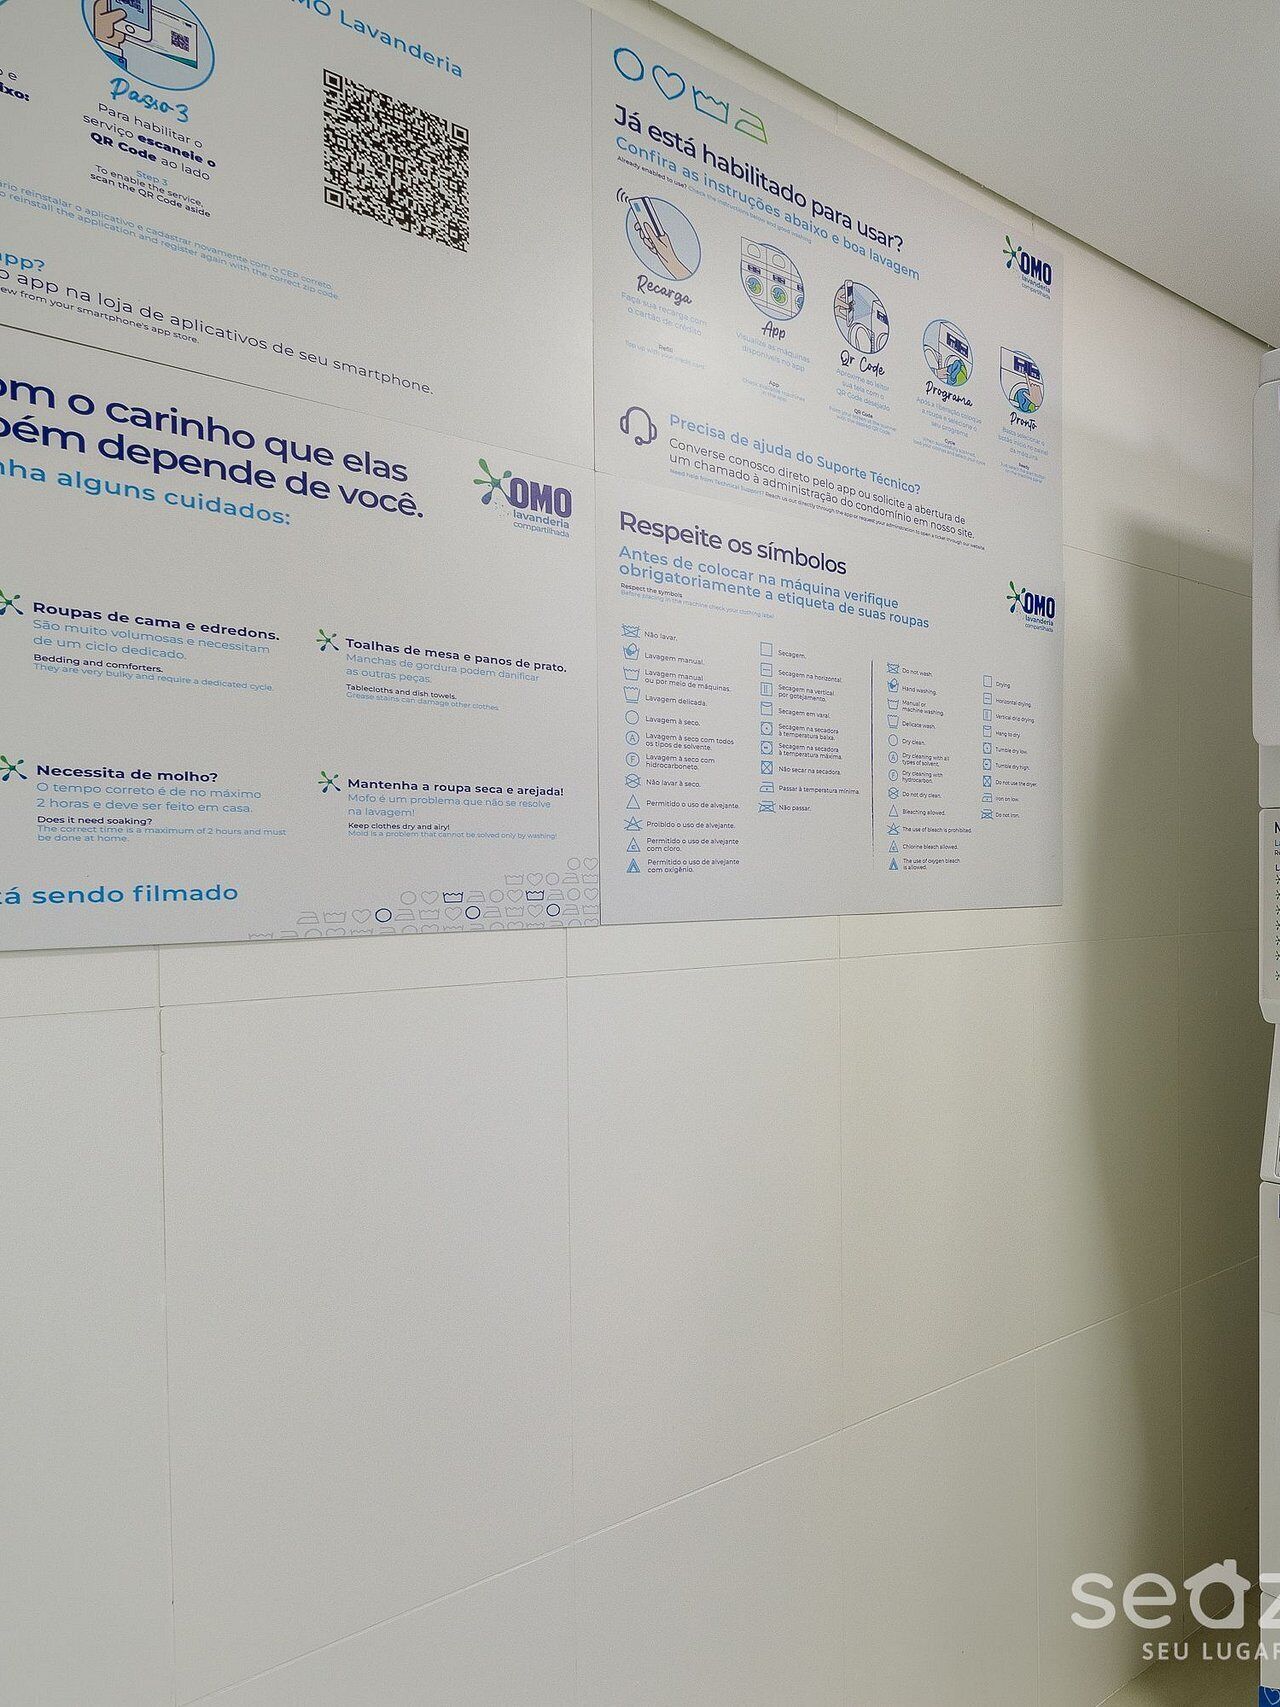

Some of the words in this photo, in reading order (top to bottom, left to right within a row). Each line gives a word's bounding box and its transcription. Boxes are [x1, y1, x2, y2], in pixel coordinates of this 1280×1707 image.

[340, 9, 462, 77] Lavanderia
[109, 77, 174, 113] Passo
[175, 103, 188, 122] 3
[83, 115, 133, 138] serviço
[137, 134, 203, 163] escaneie
[206, 159, 216, 167] o
[90, 132, 113, 147] QR
[117, 141, 156, 162] Code
[161, 157, 177, 168] ao
[181, 162, 209, 180] lado
[90, 173, 115, 186] scan
[117, 181, 135, 192] the
[137, 188, 154, 199] QR
[156, 194, 182, 208] Code
[184, 204, 210, 217] aside
[614, 103, 641, 134] Já
[648, 125, 696, 158] está
[702, 143, 806, 207] habilitado
[811, 199, 852, 230] para
[857, 220, 903, 252] usar?
[1017, 251, 1051, 285] OMO
[636, 274, 692, 305] Recarga
[17, 274, 58, 294] app
[66, 286, 90, 302] na
[98, 292, 132, 313] loja
[139, 305, 163, 321] de
[170, 315, 267, 349] aplicativos
[272, 342, 294, 356] de
[299, 351, 327, 366] seu
[333, 360, 433, 394] smartphone.
[761, 320, 785, 340] App
[840, 350, 855, 367] Qr
[859, 356, 885, 377] Code
[925, 380, 973, 407] Programa
[67, 394, 94, 415] o
[105, 402, 255, 449] carinho
[264, 436, 334, 466] que
[342, 450, 407, 482] elas
[1009, 411, 1037, 431] Pronto
[670, 413, 725, 440] Precisa
[730, 431, 748, 446] de
[752, 438, 791, 459] ajuda
[796, 450, 813, 464] do
[816, 455, 866, 479] Suporte
[869, 470, 920, 494] Técnico?
[97, 433, 276, 489] depende
[285, 470, 330, 499] de
[337, 484, 423, 518] você.
[505, 477, 572, 518] OMO
[512, 521, 569, 538] compartilhada
[513, 508, 569, 529] lavanderia
[620, 510, 722, 549] Respeite
[727, 538, 752, 555] os
[757, 541, 846, 575] símbolos
[618, 545, 668, 569] Antes
[672, 555, 693, 570] de
[697, 562, 754, 581] colocar
[758, 573, 775, 586] na
[780, 578, 840, 598] máquina
[843, 590, 898, 609] verifique
[33, 602, 102, 620] Roupas
[107, 611, 129, 623] de
[134, 616, 180, 629] cama
[185, 622, 195, 630] e
[200, 623, 279, 640] edredons.
[1021, 593, 1055, 618] OMO
[33, 653, 80, 666] Bedding
[82, 659, 103, 667] and
[37, 764, 124, 778] Necessita
[130, 768, 152, 779] de
[157, 771, 218, 782] molho?
[32, 885, 123, 904] sendo
[132, 884, 238, 902] filmado
